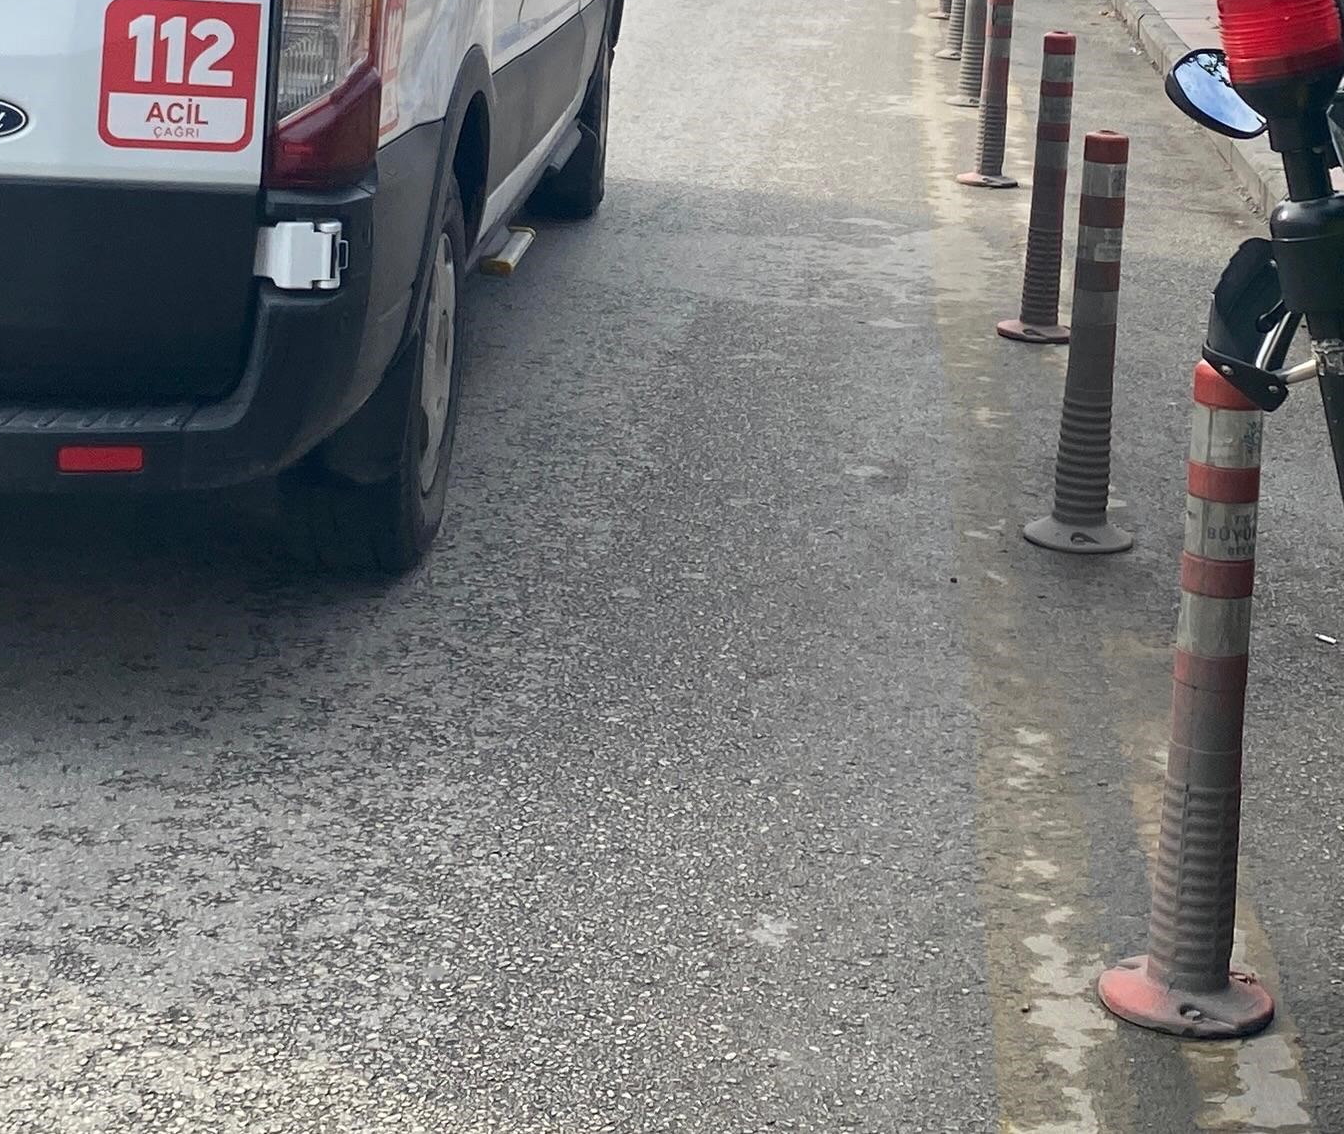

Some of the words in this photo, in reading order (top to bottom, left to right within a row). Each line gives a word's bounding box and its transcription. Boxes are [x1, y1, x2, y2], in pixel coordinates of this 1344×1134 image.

[128, 14, 235, 87] 112
[145, 97, 208, 125] ACİL
[153, 125, 199, 139] ÇAĞRI
